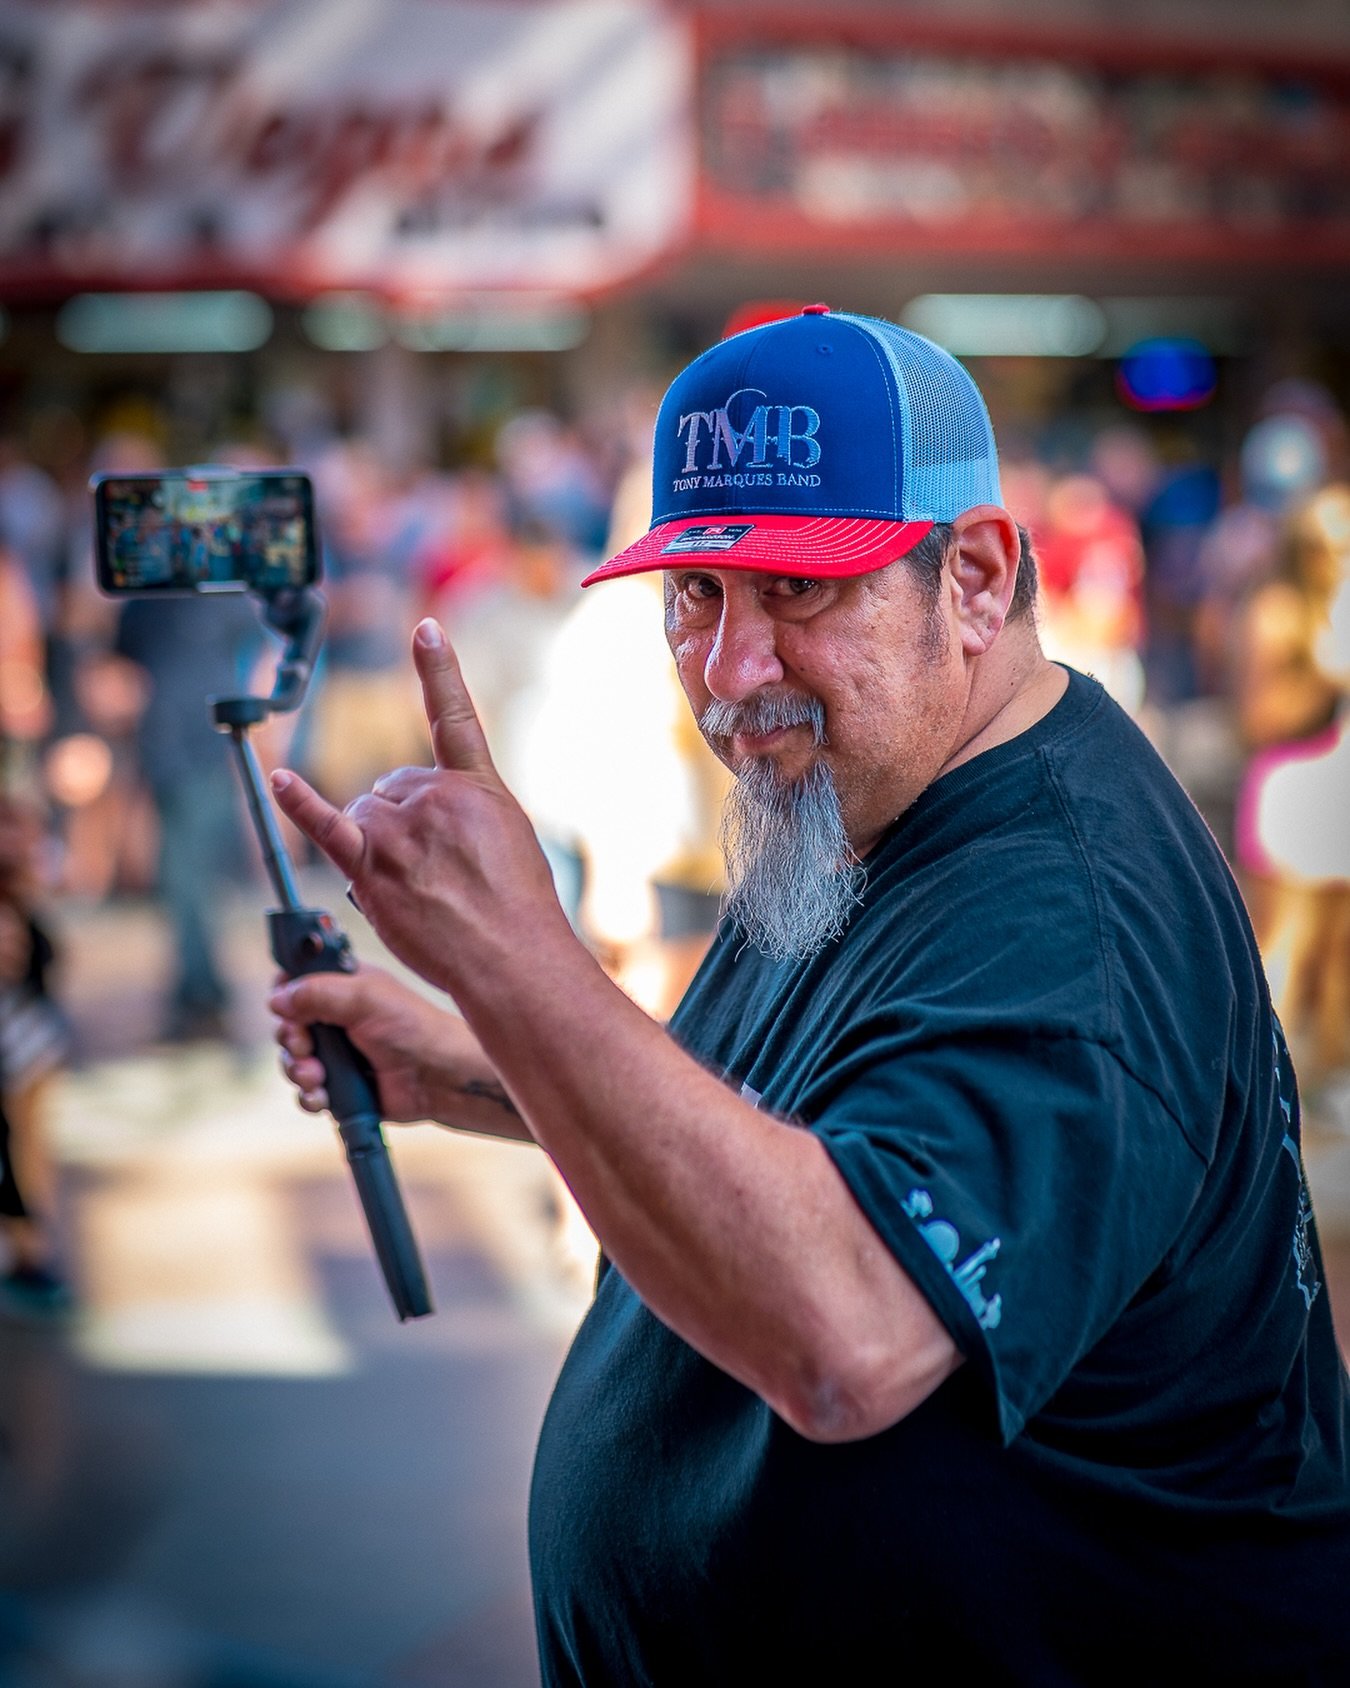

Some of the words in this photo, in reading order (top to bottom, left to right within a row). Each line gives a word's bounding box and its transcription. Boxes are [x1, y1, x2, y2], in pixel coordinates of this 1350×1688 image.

[677, 403, 822, 474] TMB
[673, 476, 702, 493] TONY
[702, 473, 773, 488] MARQUES
[776, 473, 822, 488] BAND
